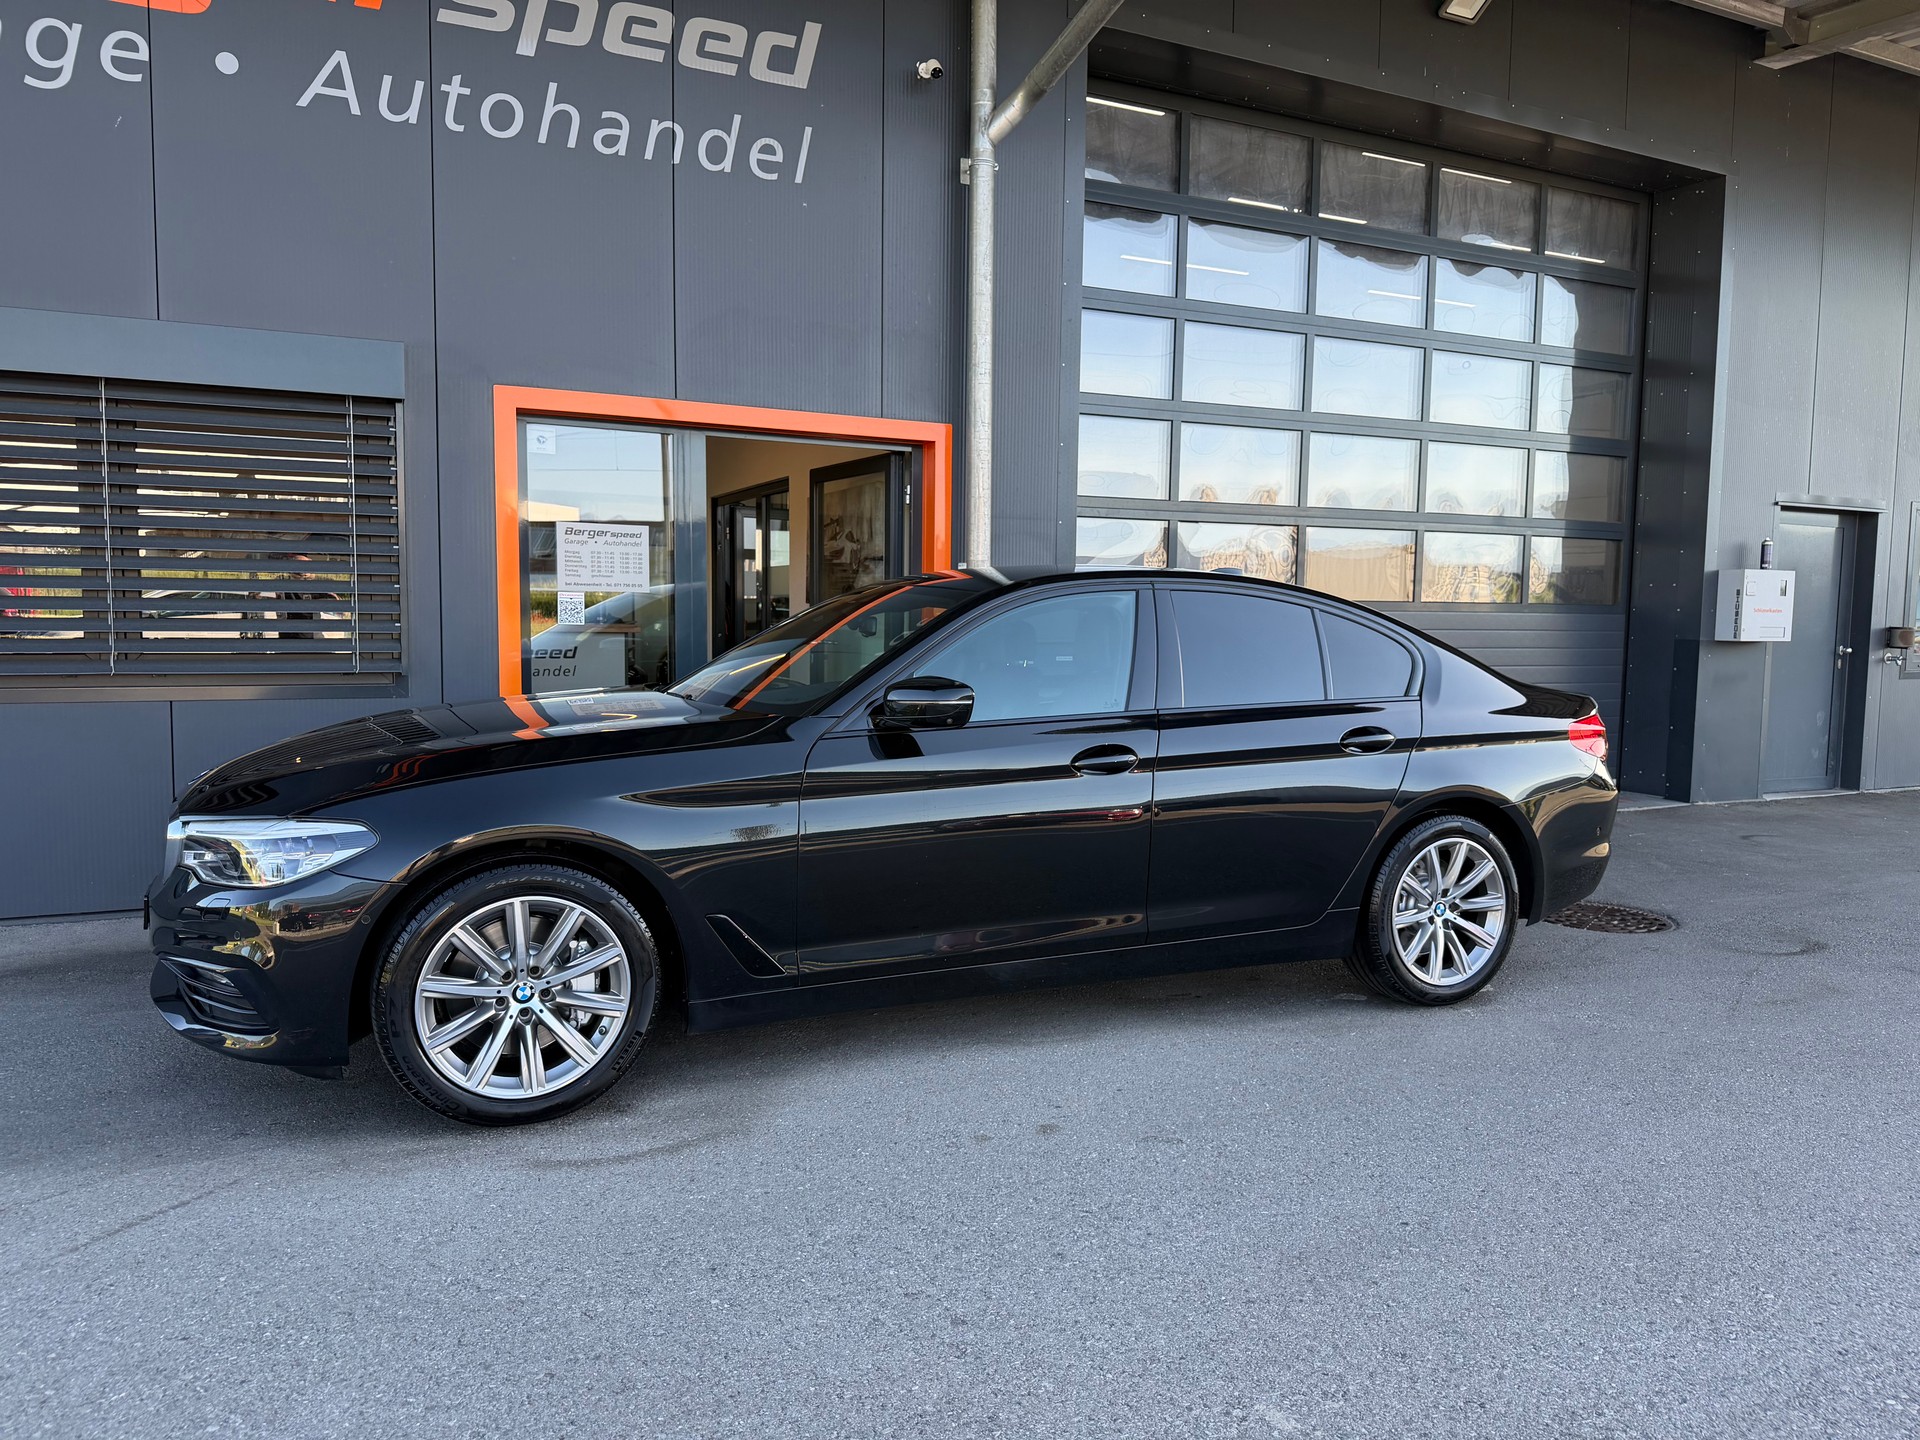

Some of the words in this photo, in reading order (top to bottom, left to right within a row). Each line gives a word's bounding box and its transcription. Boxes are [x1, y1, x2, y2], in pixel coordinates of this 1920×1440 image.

[0, 17, 149, 90] ge
[296, 49, 813, 184] Autohandel
[564, 527, 642, 539] Bergerspeed
[564, 538, 589, 546] Garage
[1733, 588, 1741, 639] PORSCHE
[531, 646, 578, 659] eed
